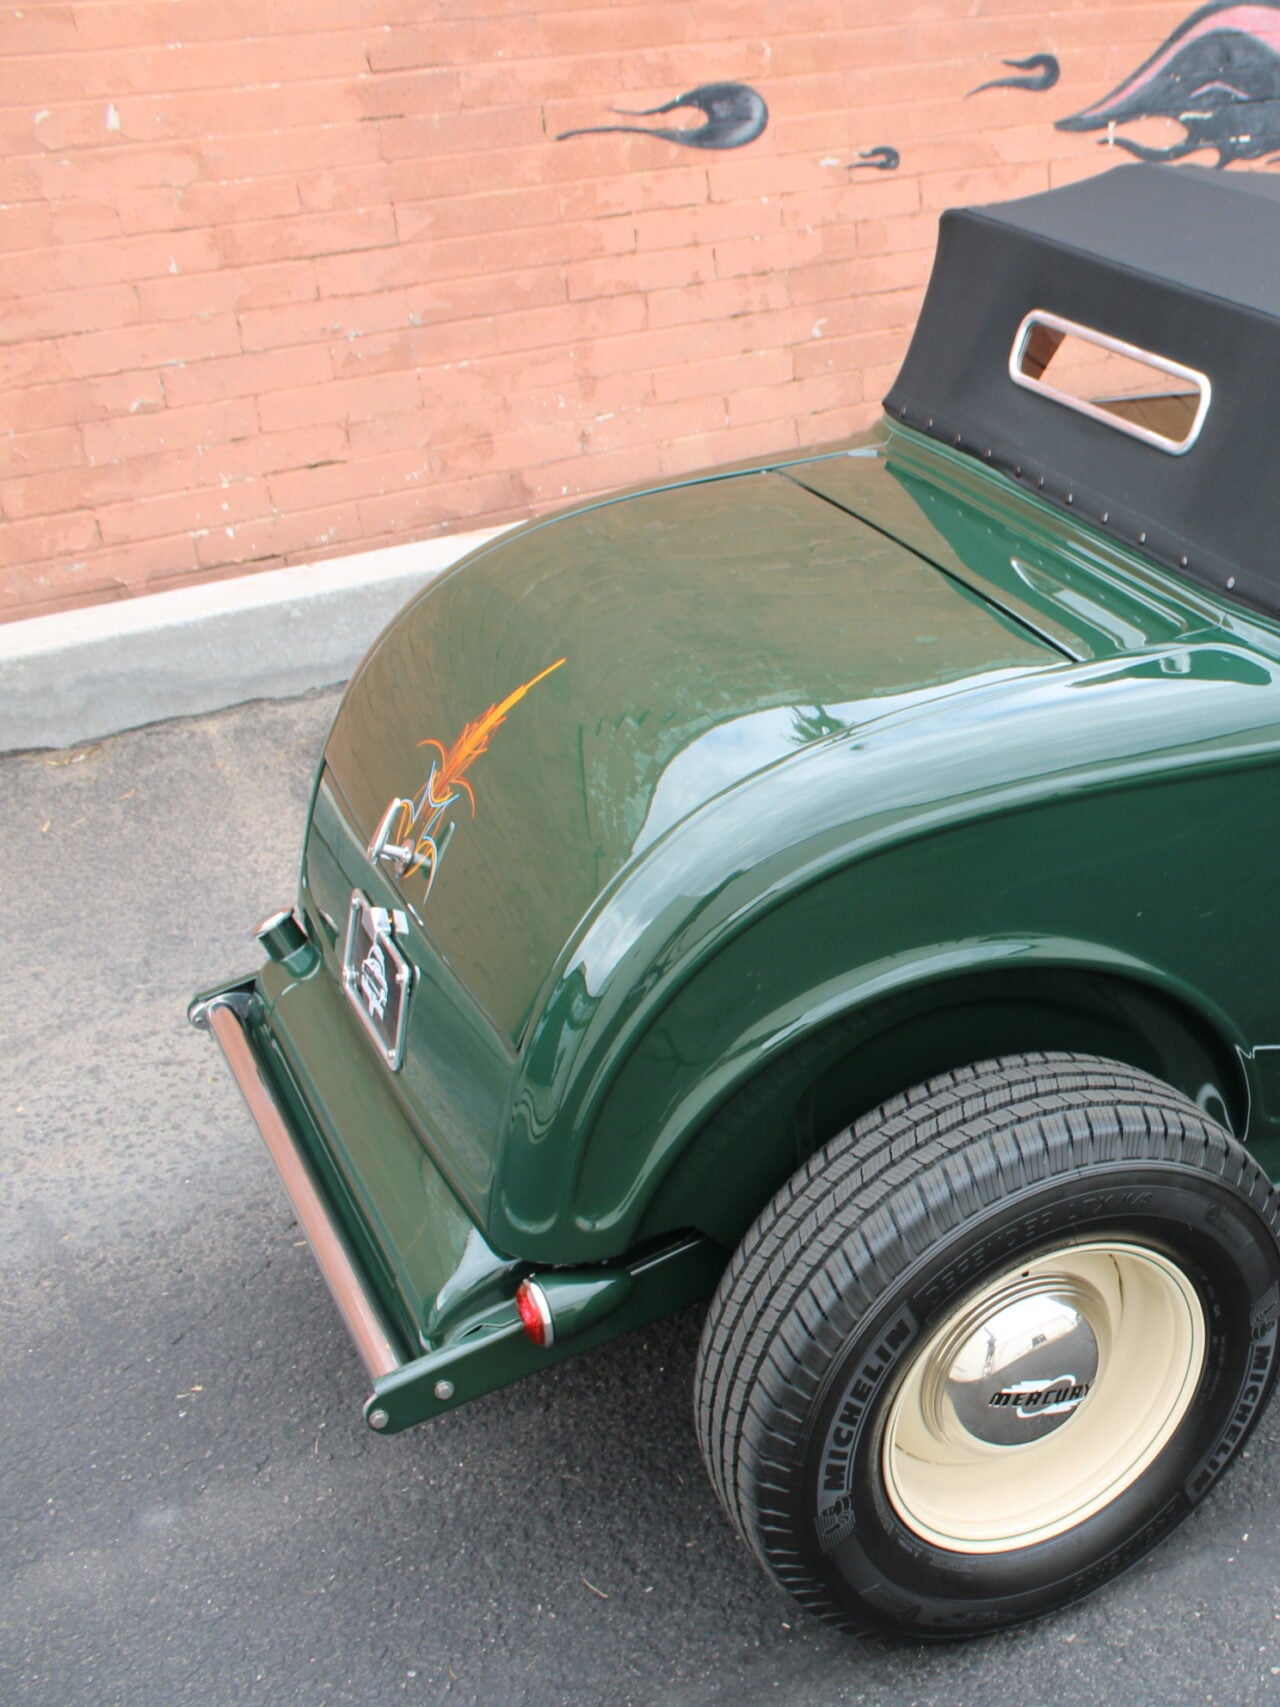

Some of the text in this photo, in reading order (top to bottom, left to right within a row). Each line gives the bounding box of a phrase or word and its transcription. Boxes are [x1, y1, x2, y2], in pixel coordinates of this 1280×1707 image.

[823, 1318, 911, 1492] MICHELIN
[988, 1381, 1094, 1407] MERCURY
[1192, 1345, 1271, 1494] MICHELIN
